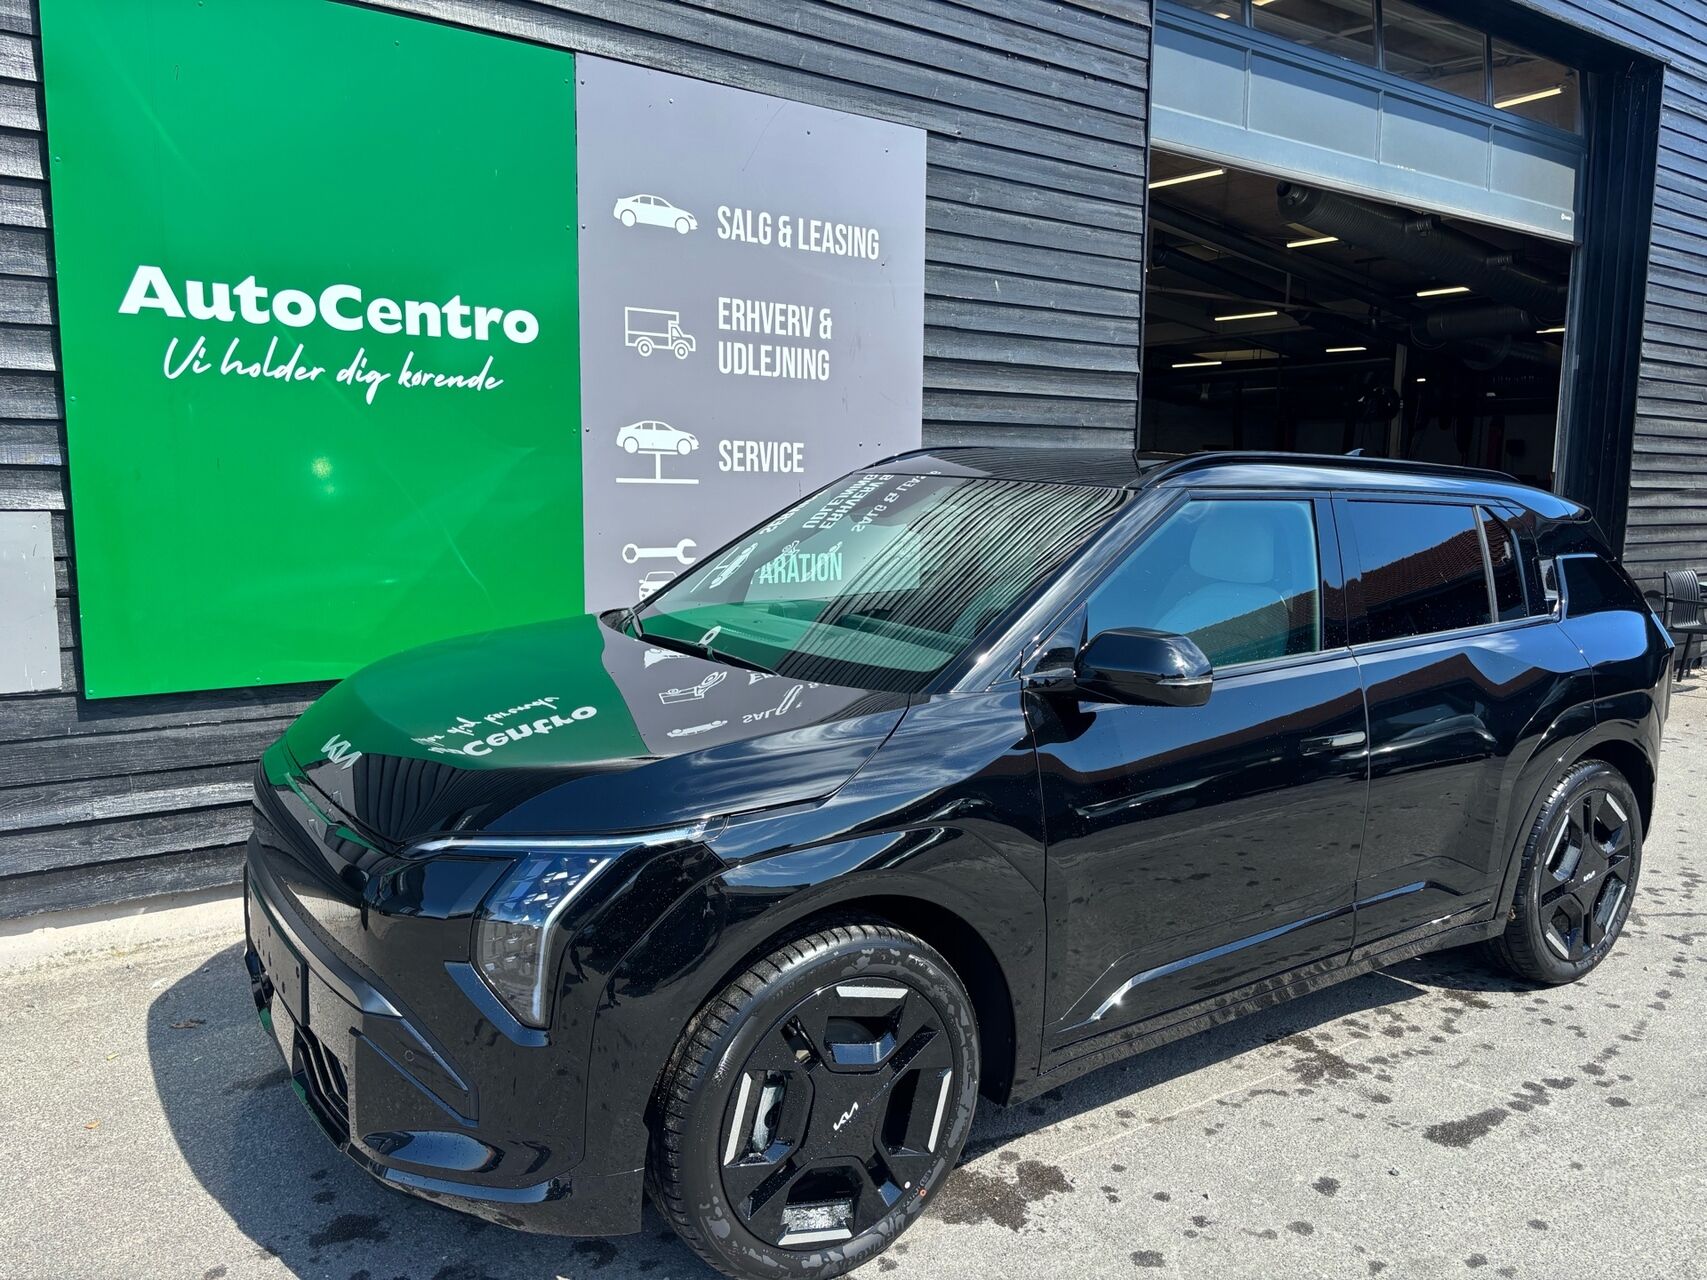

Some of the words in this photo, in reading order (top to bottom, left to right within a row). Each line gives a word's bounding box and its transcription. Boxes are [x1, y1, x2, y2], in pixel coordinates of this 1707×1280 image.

[717, 205, 772, 246] SALG
[778, 215, 793, 249] &
[798, 217, 880, 260] LEASING
[118, 264, 540, 344] AutoCentro
[717, 296, 814, 338] ERHVERV
[819, 308, 833, 340] &
[163, 336, 211, 380] Vi
[220, 336, 326, 382] holder
[335, 348, 391, 405] dig
[717, 341, 830, 381] UDLEJNING
[717, 439, 805, 473] SERVICE
